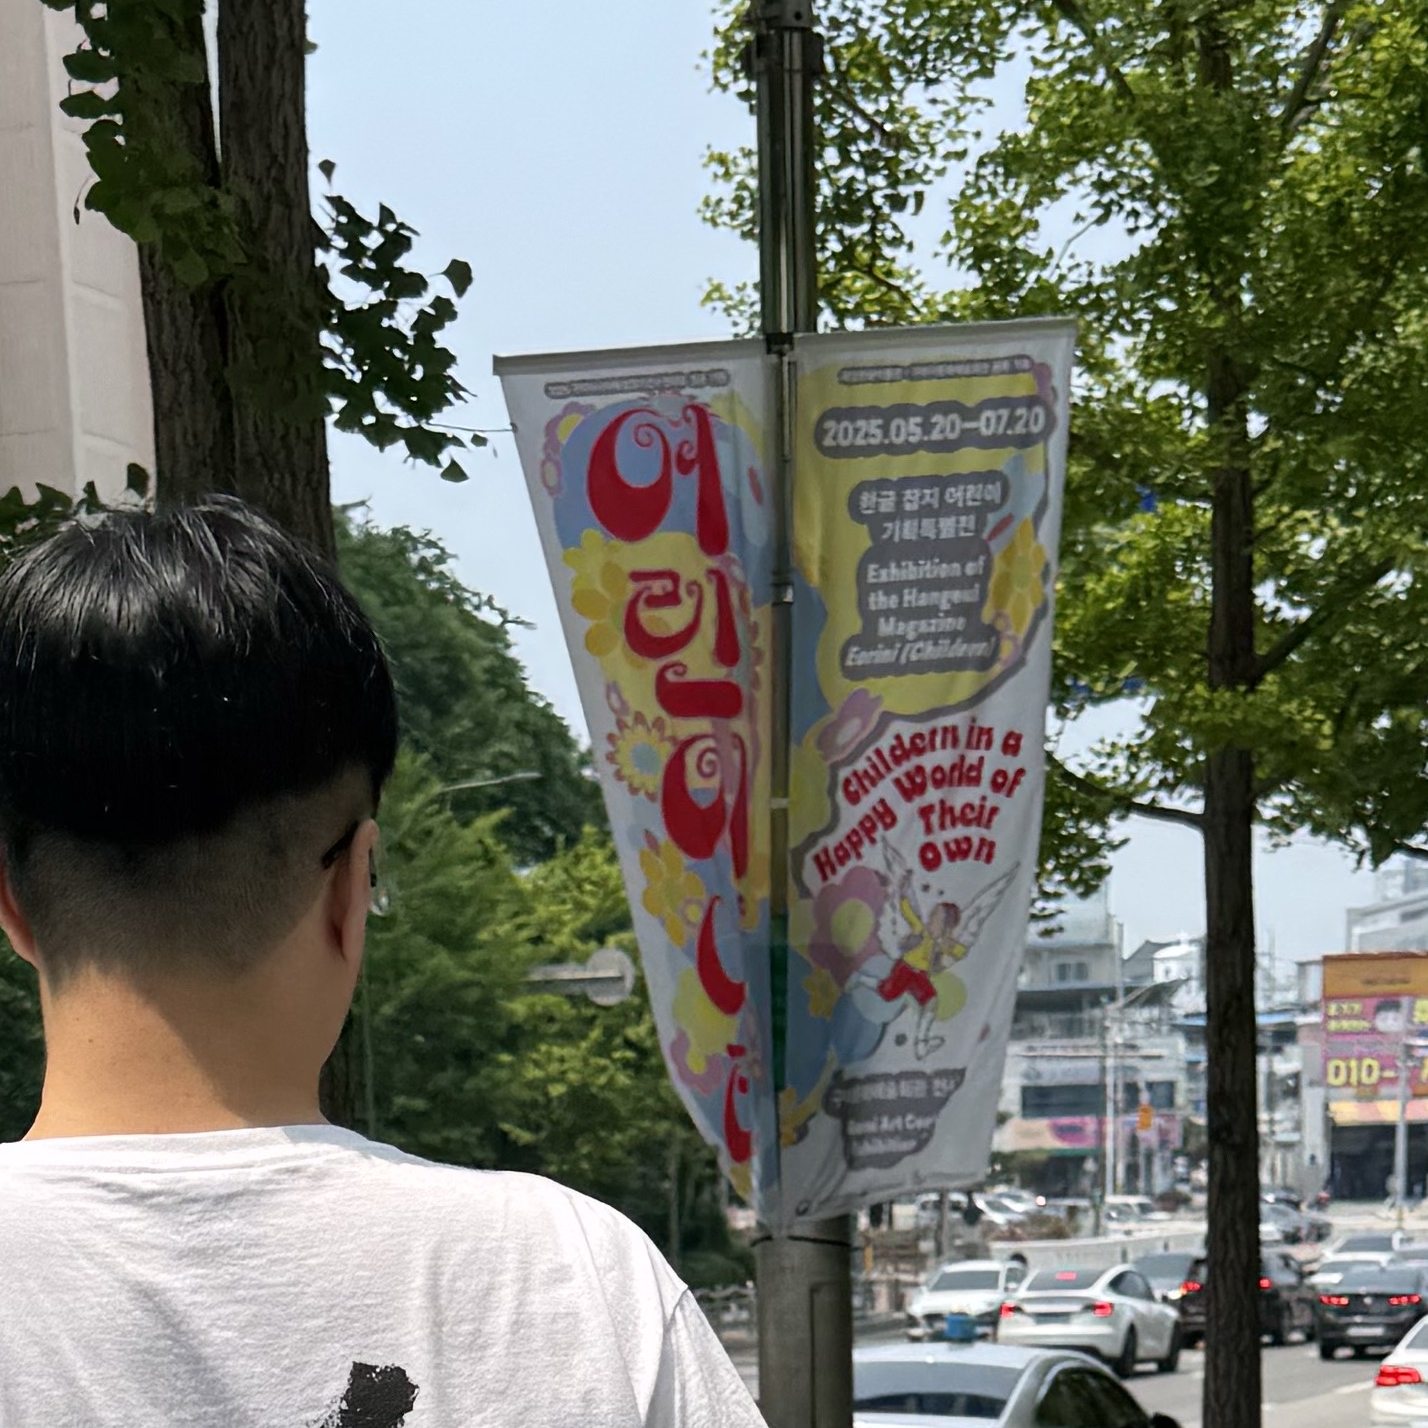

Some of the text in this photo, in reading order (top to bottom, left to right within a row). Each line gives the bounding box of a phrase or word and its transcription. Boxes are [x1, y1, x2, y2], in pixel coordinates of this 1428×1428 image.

[859, 481, 1002, 515] 한글 잡지 어린이
[866, 554, 987, 584] Exhibition of
[868, 589, 900, 611] the
[587, 403, 749, 880] 어린이
[877, 612, 967, 641] Magazine
[965, 717, 994, 751] in
[1002, 730, 1024, 758] a
[813, 754, 1027, 882] Happy World of
[916, 795, 1000, 836] Their
[917, 836, 996, 872] Own
